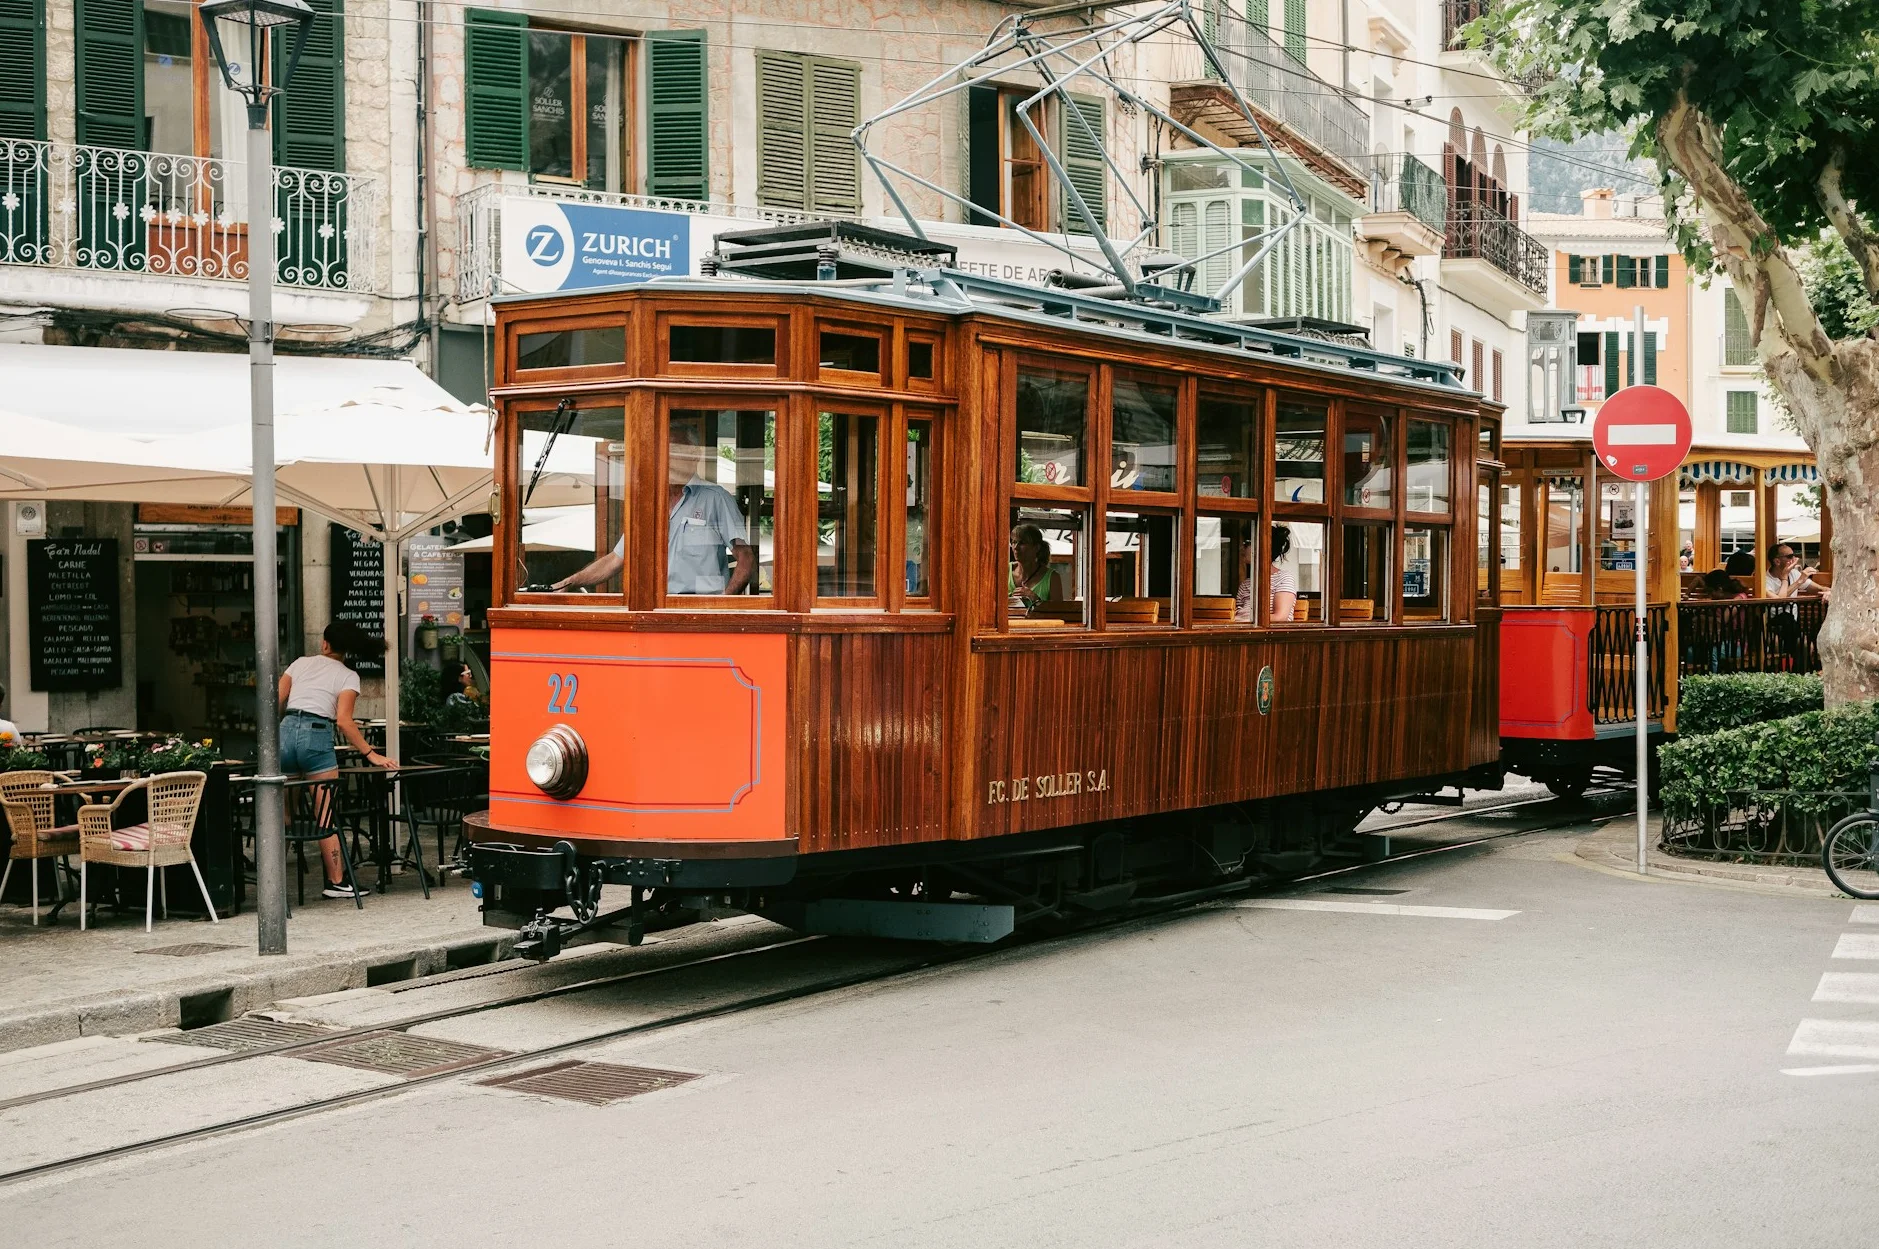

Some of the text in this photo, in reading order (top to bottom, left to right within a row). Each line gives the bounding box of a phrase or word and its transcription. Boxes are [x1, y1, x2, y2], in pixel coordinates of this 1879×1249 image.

[535, 97, 563, 107] SOLLER
[532, 105, 565, 115] SANCHIS
[582, 232, 671, 259] ZURICH
[582, 255, 618, 266] Genoveva
[625, 259, 651, 269] Sanchis
[959, 261, 998, 278] FETE
[1004, 265, 1023, 280] DE
[73, 543, 102, 555] Nadal
[58, 560, 86, 569] CARNE
[48, 593, 72, 601] LOMO
[370, 599, 384, 607] BRU
[58, 624, 93, 632] PESCADO
[43, 635, 74, 643] CALAMAR
[547, 672, 579, 715] 22
[1011, 776, 1030, 801] DE
[1035, 772, 1082, 799] SOLLER
[1086, 769, 1111, 792] S.A.
